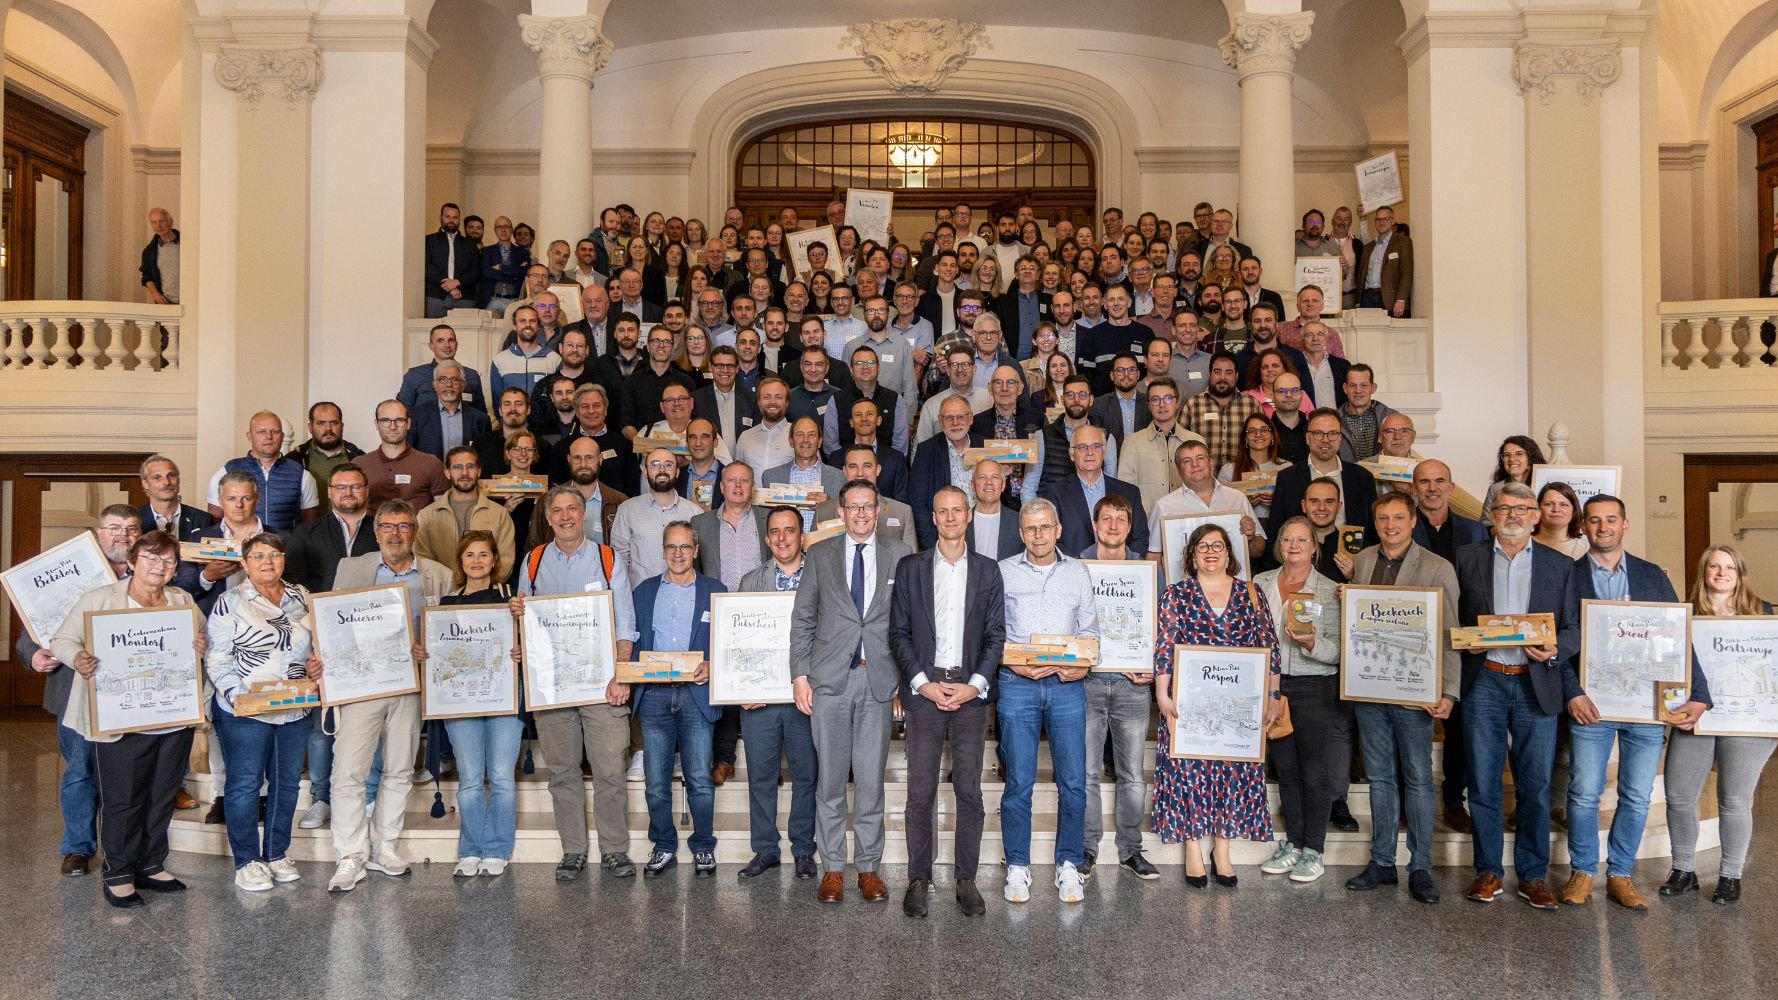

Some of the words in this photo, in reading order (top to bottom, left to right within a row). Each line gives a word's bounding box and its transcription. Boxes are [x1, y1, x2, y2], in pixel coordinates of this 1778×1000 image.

[33, 564, 81, 588] Betzdorf
[1100, 578, 1118, 587] Green
[1092, 585, 1136, 599] ttelbrück
[336, 609, 384, 625] Schieren
[1360, 611, 1384, 624] Campus
[1370, 602, 1424, 618] Beckerich
[537, 617, 599, 631] Weiswampach
[731, 613, 777, 629] Putscheid
[450, 622, 497, 637] Diekirch
[1616, 621, 1650, 640] Saeul
[110, 633, 165, 652] Mondorf
[1712, 636, 1776, 659] Bertrange
[1201, 665, 1241, 685] Rosport
[1228, 663, 1241, 671] Pakt
